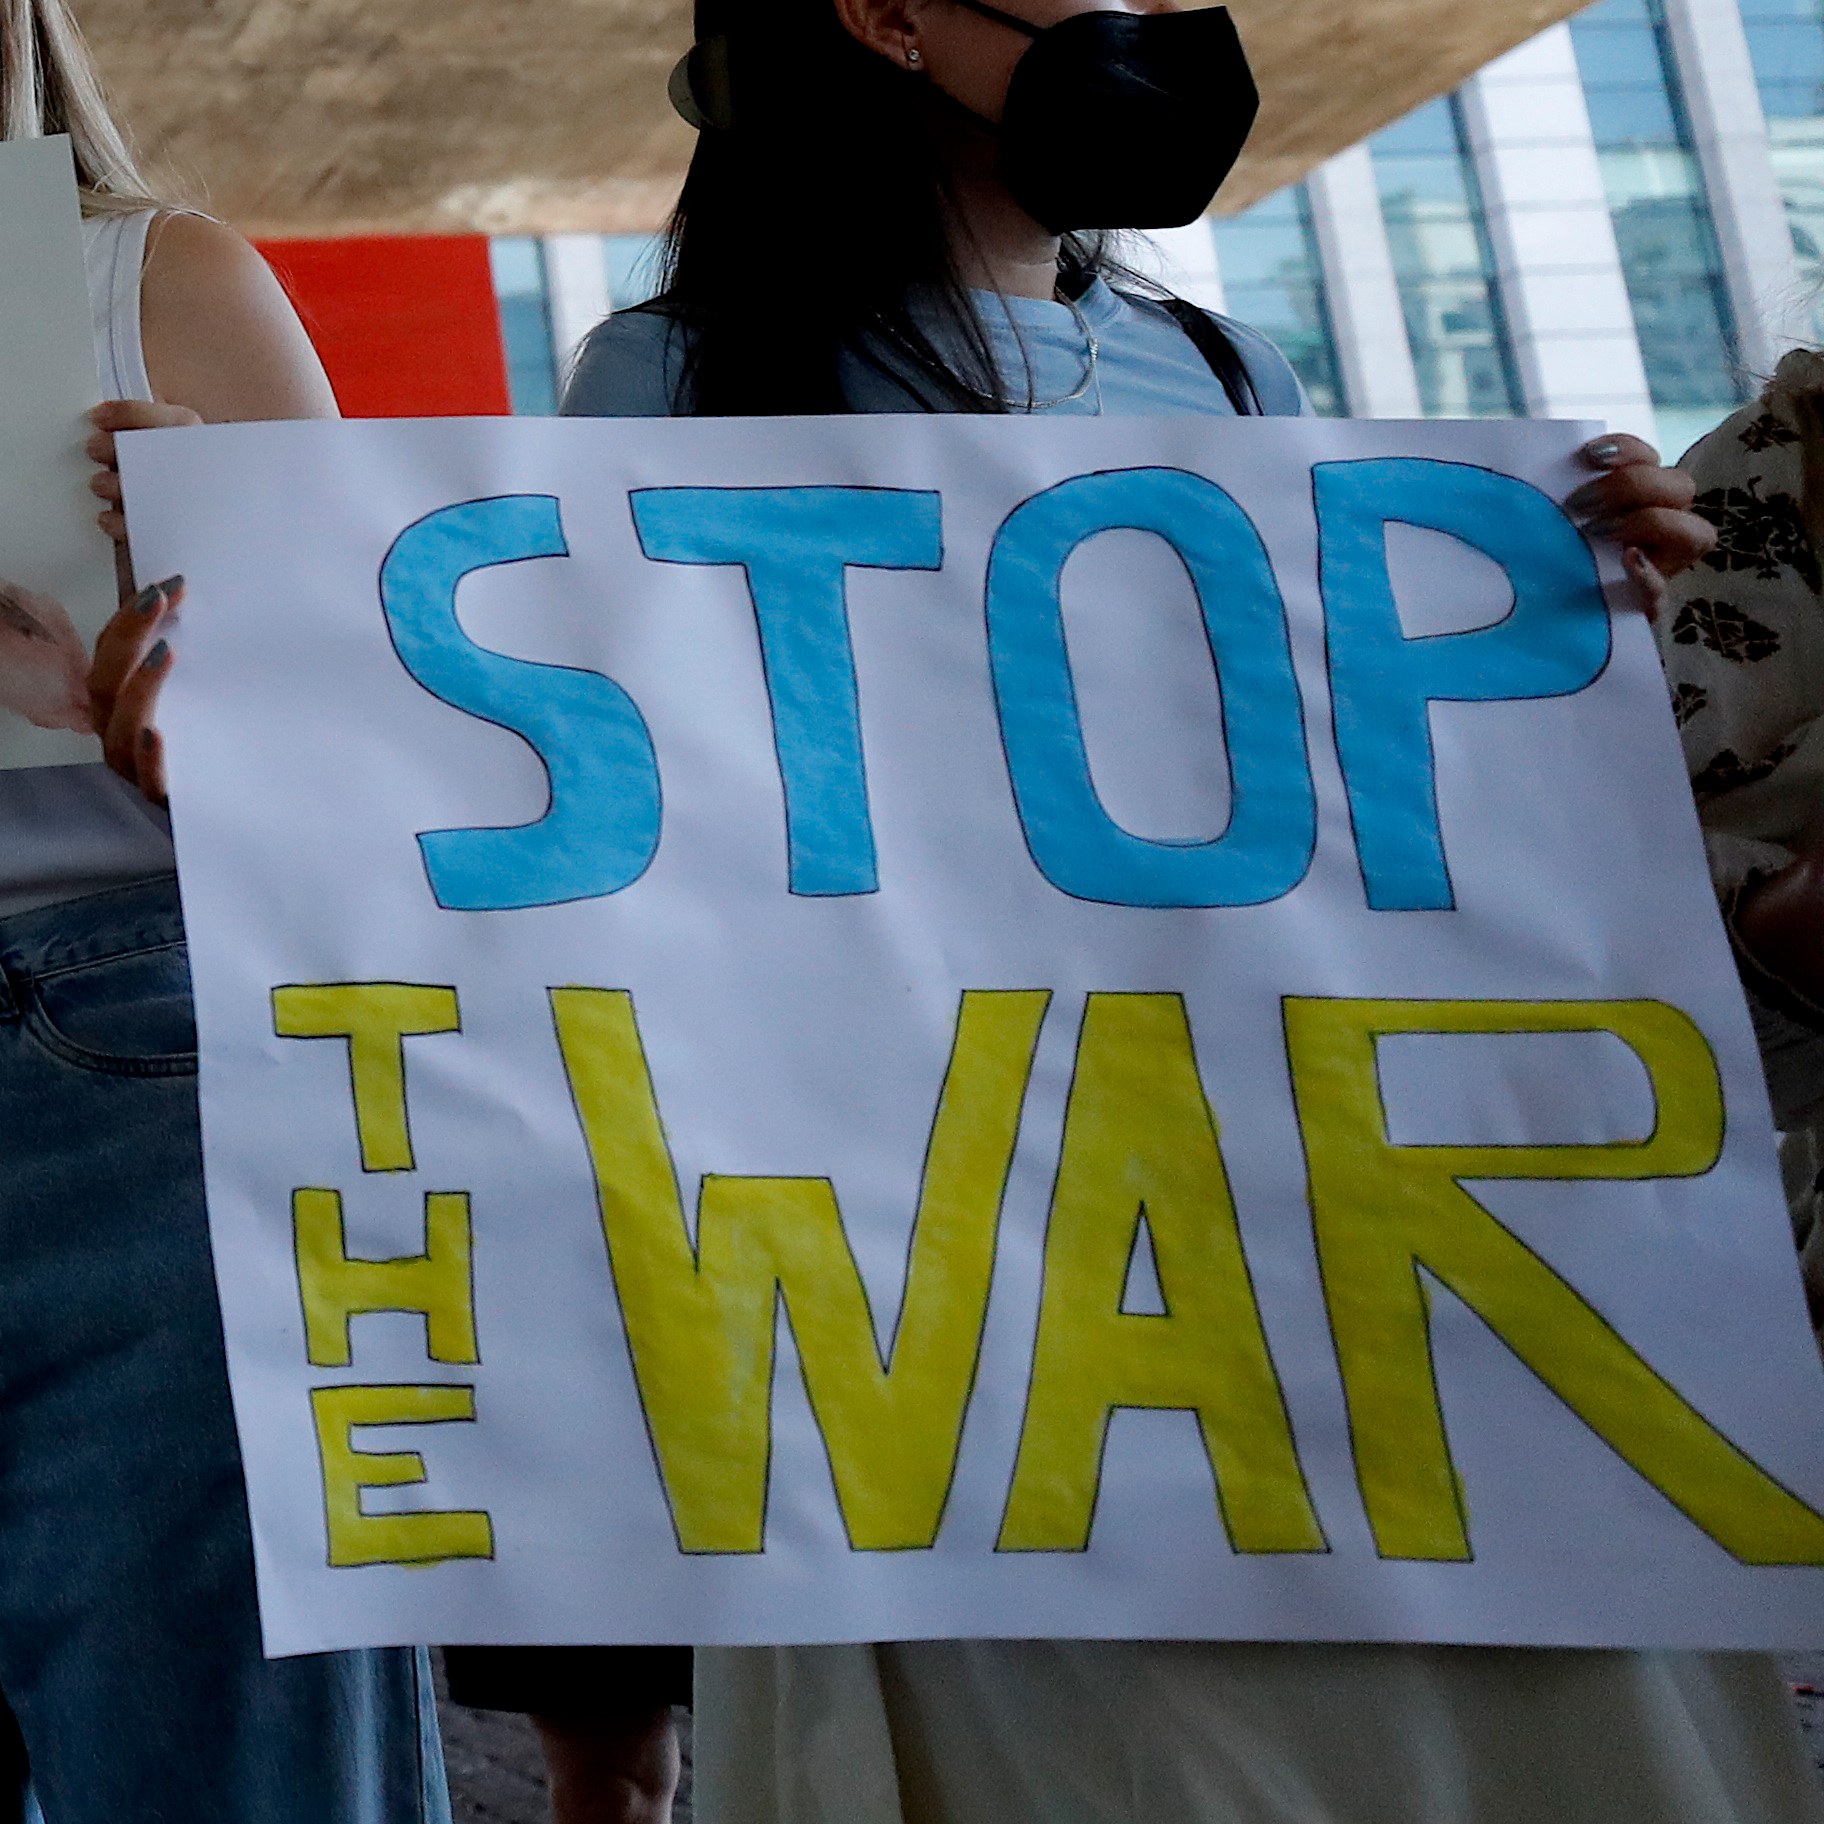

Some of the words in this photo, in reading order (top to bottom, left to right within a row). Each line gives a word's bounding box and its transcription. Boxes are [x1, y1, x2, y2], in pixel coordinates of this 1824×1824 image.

[378, 457, 1613, 911] STOP
[270, 981, 495, 1569] THE
[546, 987, 1824, 1567] WAR
